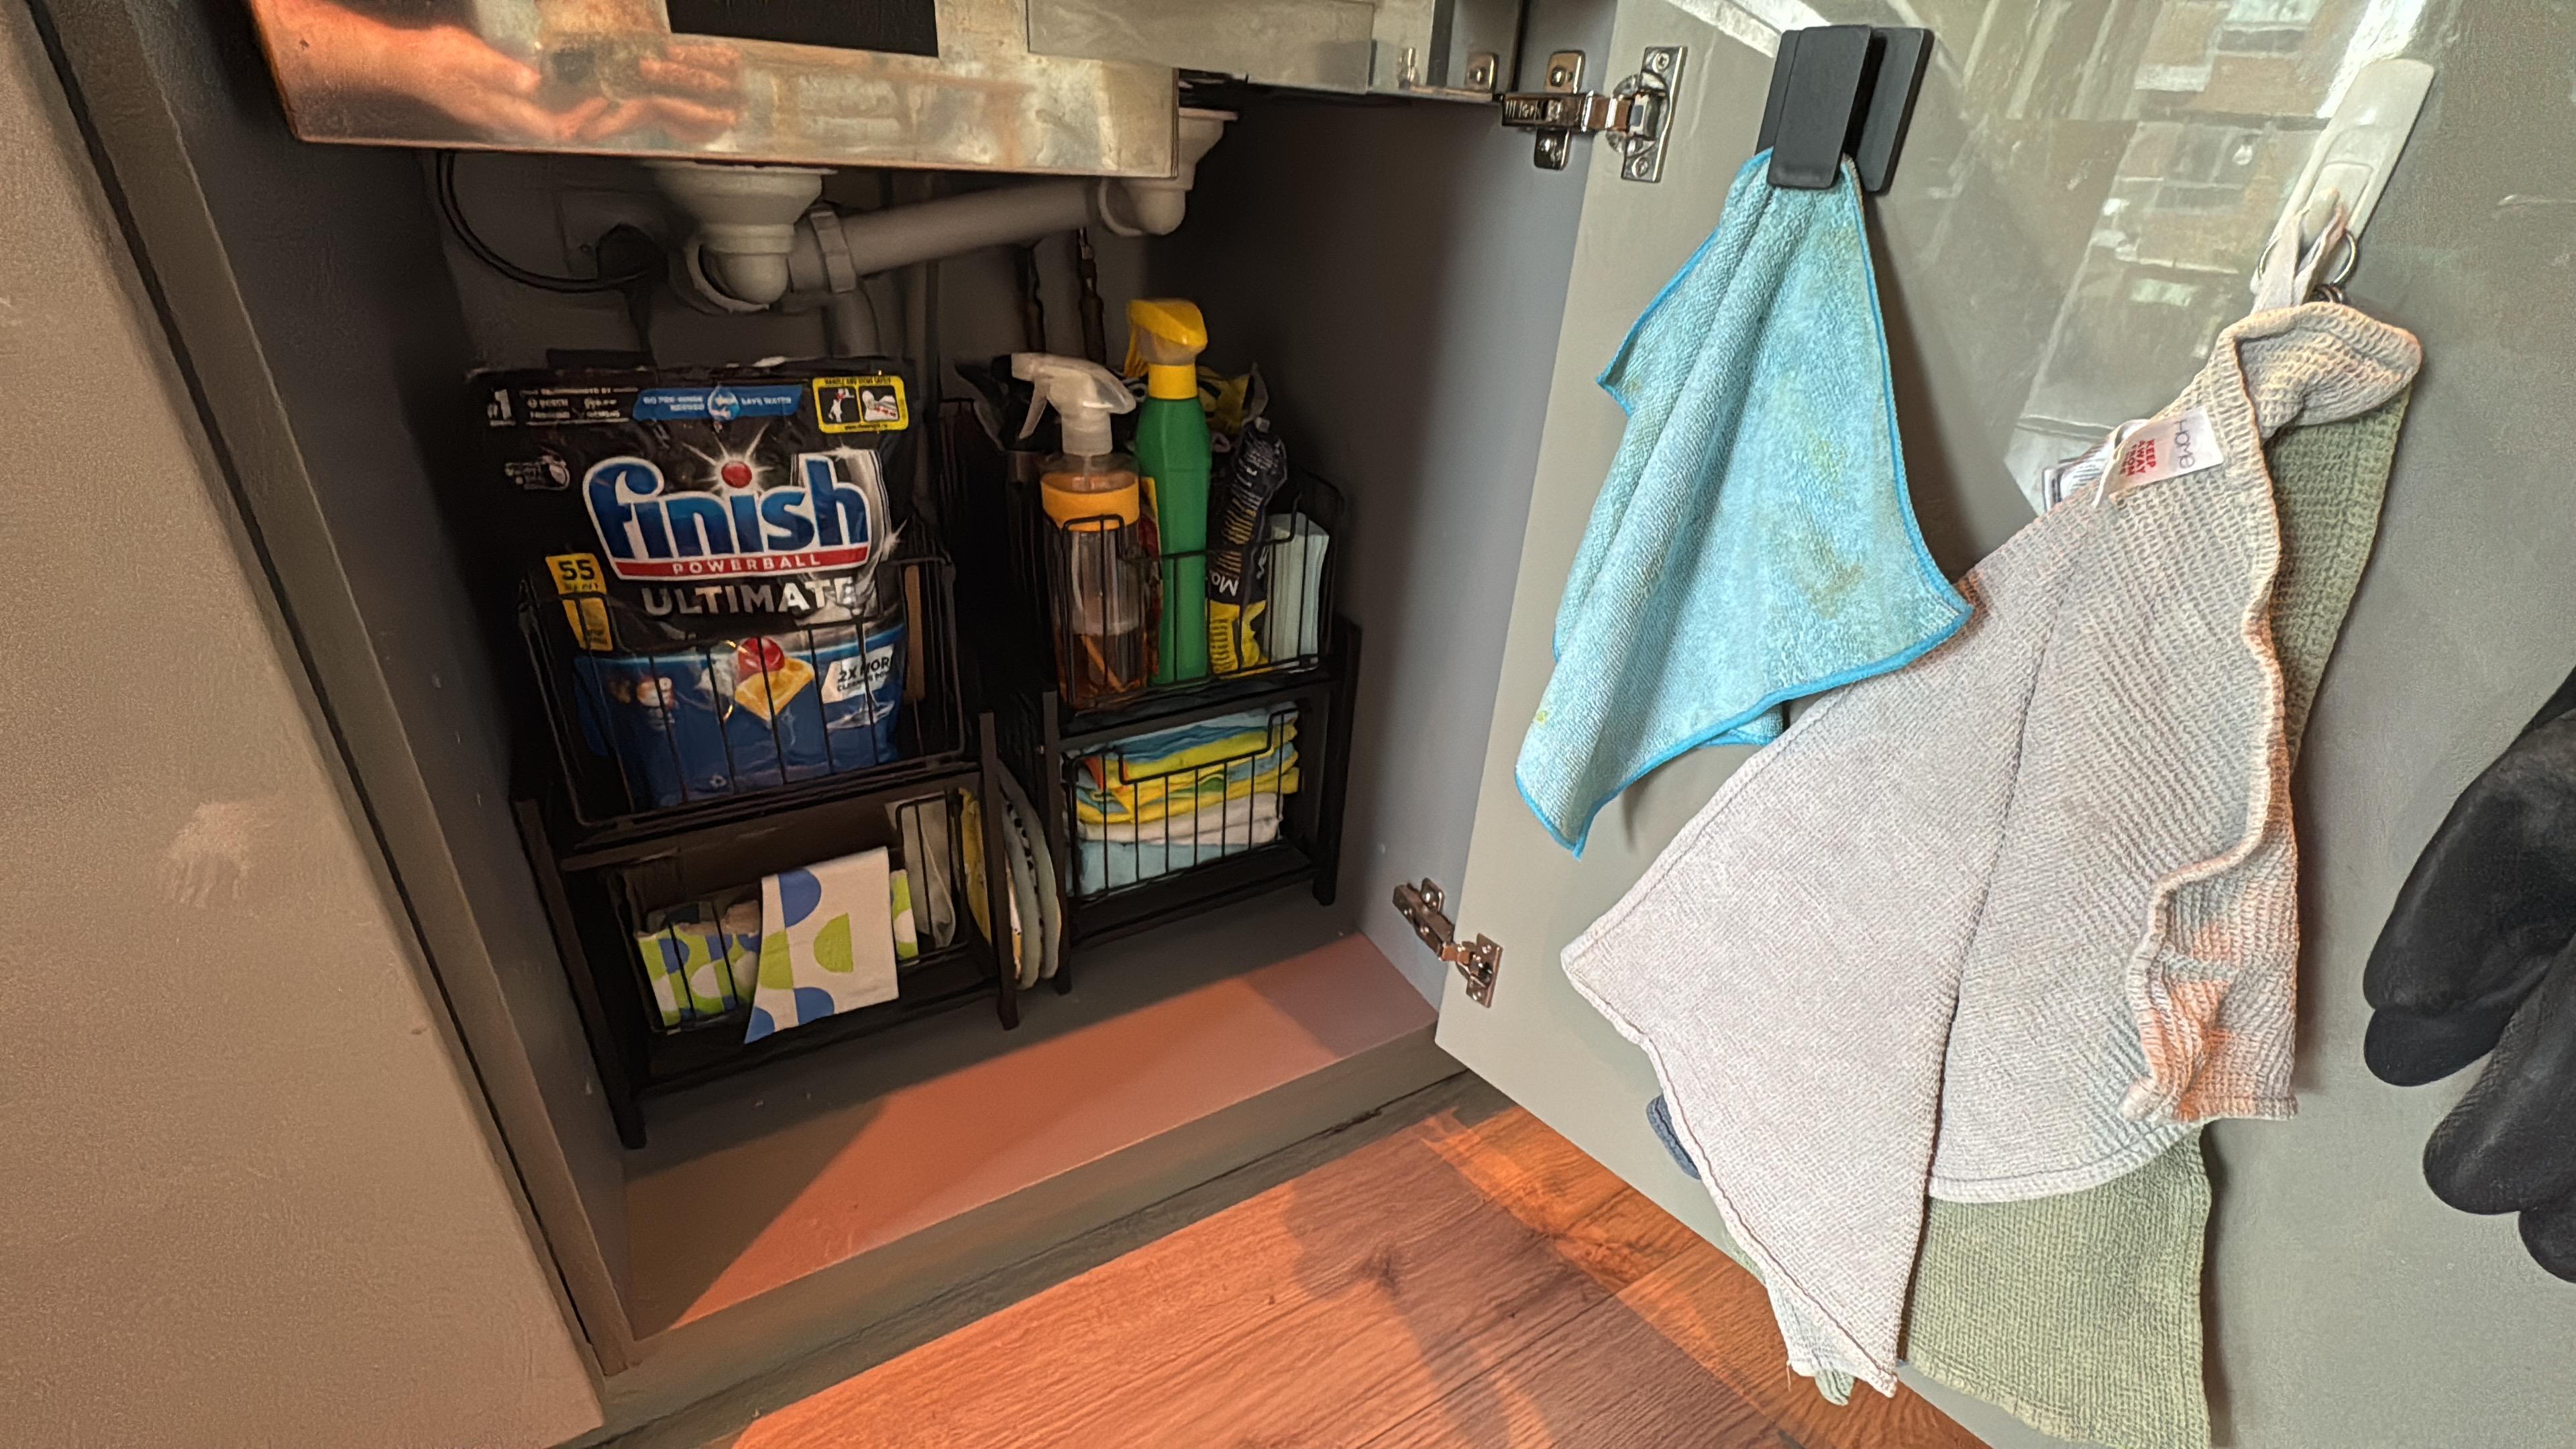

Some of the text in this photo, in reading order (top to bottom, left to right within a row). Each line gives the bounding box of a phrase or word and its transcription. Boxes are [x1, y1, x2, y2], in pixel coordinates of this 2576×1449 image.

[2136, 440, 2146, 474] AWAY
[2146, 438, 2156, 468] KEEP
[588, 459, 869, 559] finish
[557, 559, 595, 580] 55
[672, 554, 821, 575] POWERBALL
